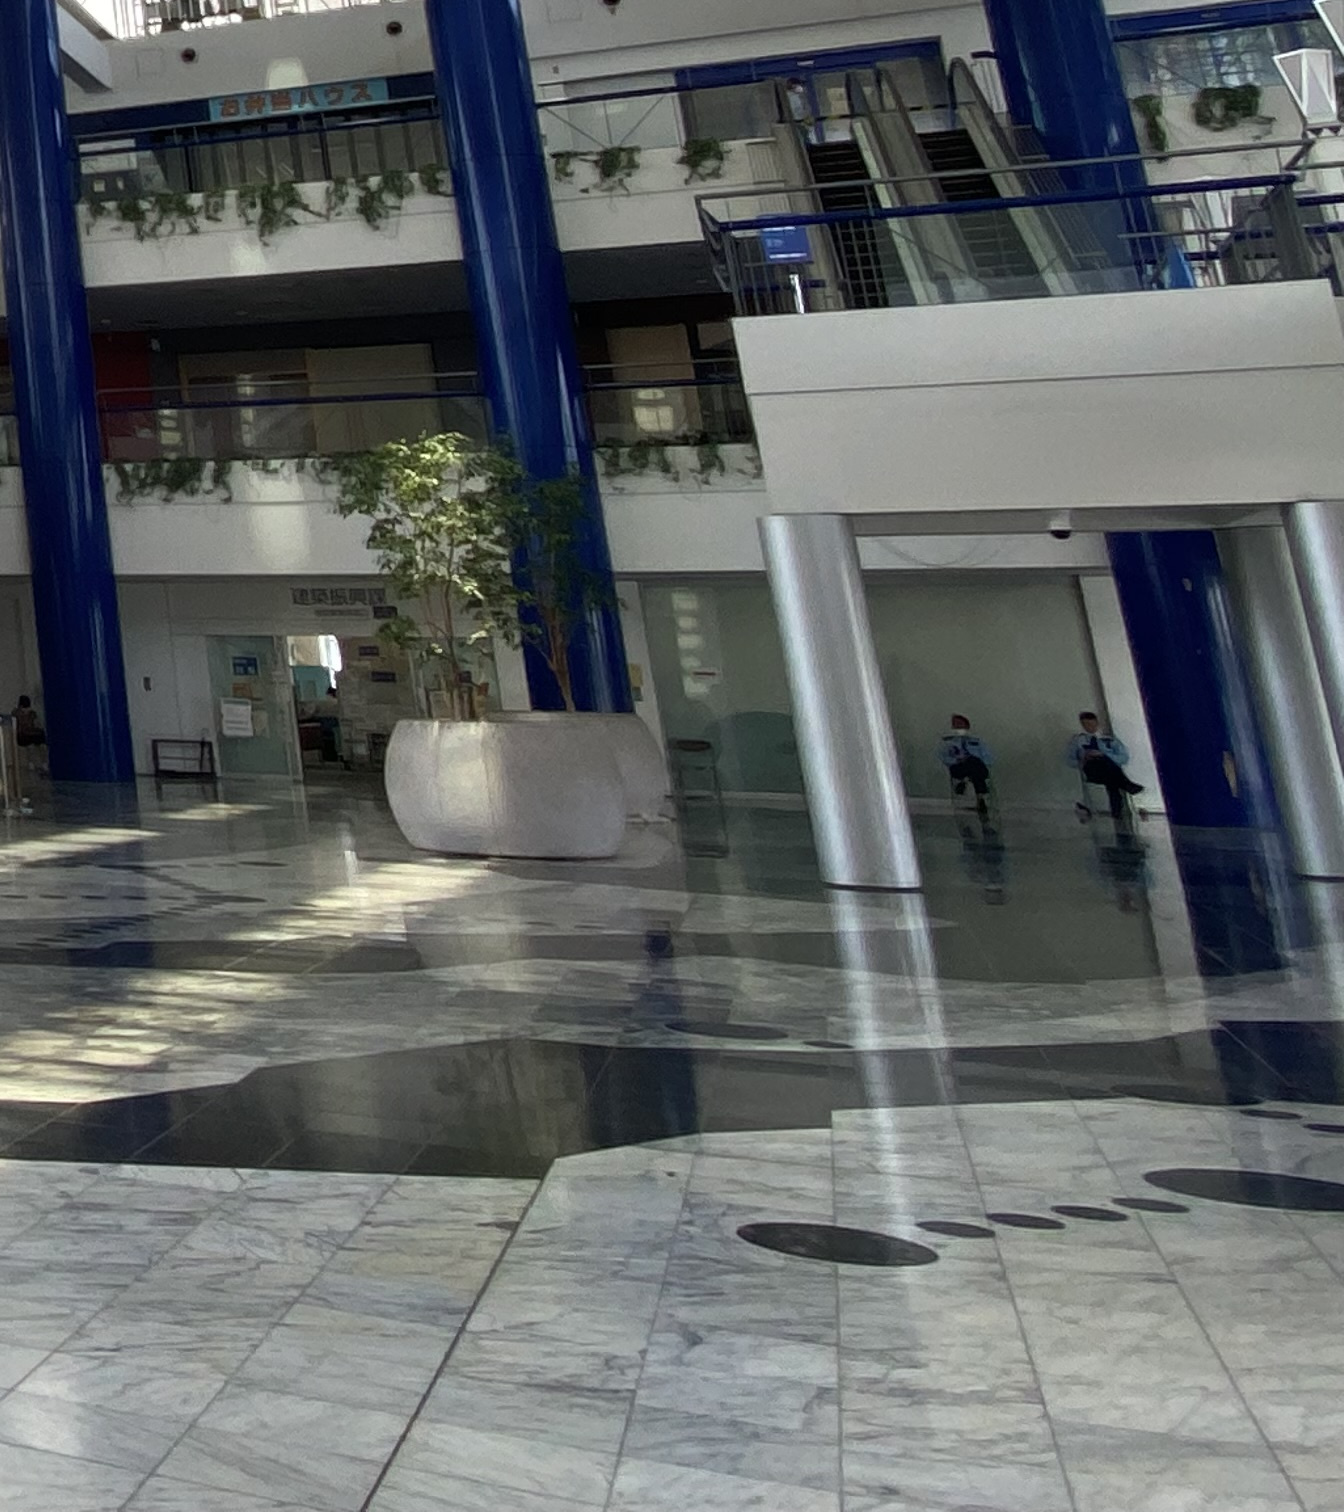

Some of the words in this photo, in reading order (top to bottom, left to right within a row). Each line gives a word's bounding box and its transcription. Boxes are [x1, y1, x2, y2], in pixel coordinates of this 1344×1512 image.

[221, 82, 373, 118] お弁当ハウス
